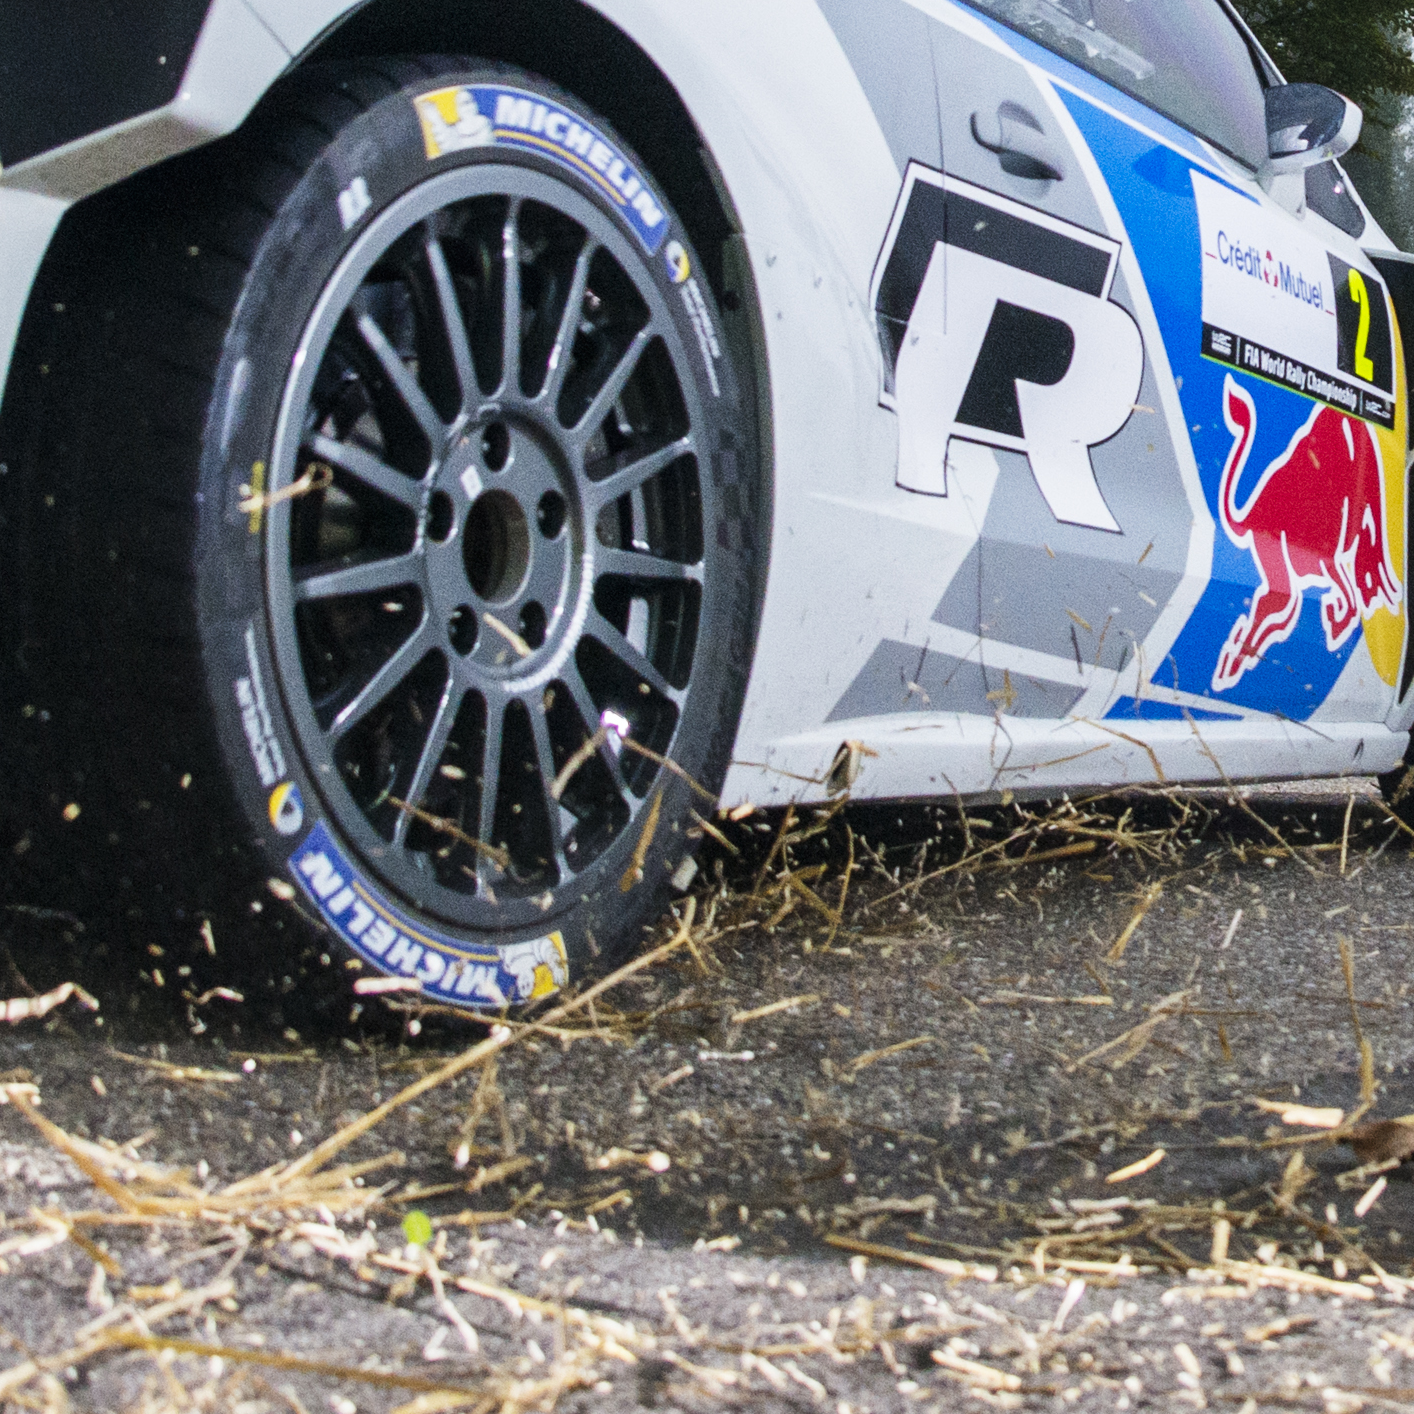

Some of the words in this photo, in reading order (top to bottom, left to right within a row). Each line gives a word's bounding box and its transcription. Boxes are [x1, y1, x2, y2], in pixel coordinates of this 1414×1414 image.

[494, 95, 663, 228] MICHELIN
[1217, 230, 1262, 280] Crédit
[1278, 260, 1324, 310] Mutuel
[1348, 267, 1374, 382] 2
[869, 158, 1146, 536] R
[1243, 343, 1260, 369] FIA
[300, 850, 501, 998] MICHELIN
